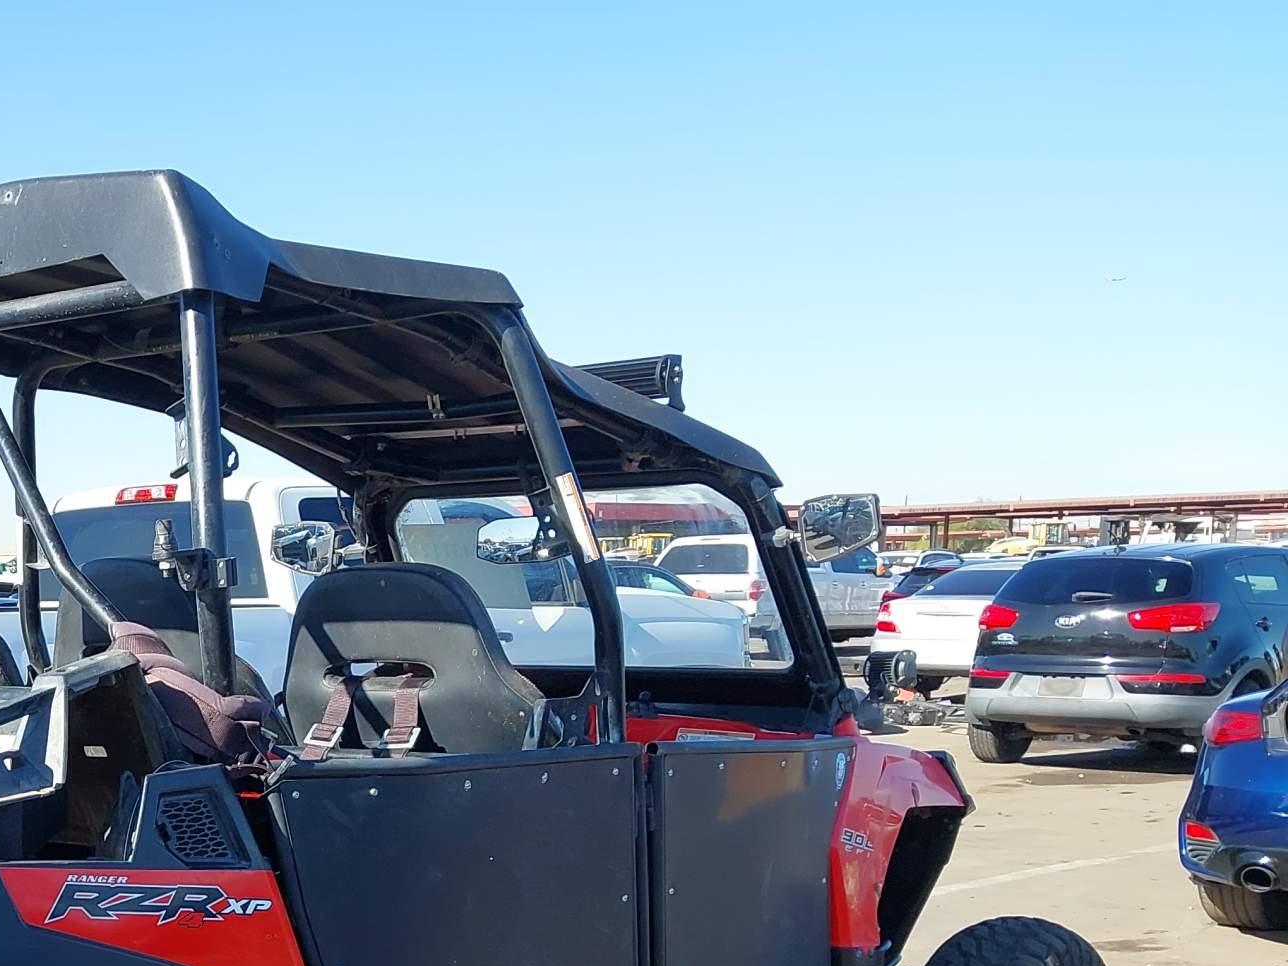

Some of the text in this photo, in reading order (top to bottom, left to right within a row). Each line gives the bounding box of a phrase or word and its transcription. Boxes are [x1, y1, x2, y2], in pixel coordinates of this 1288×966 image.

[67, 874, 128, 884] RANGER
[44, 882, 273, 926] RZR XP
